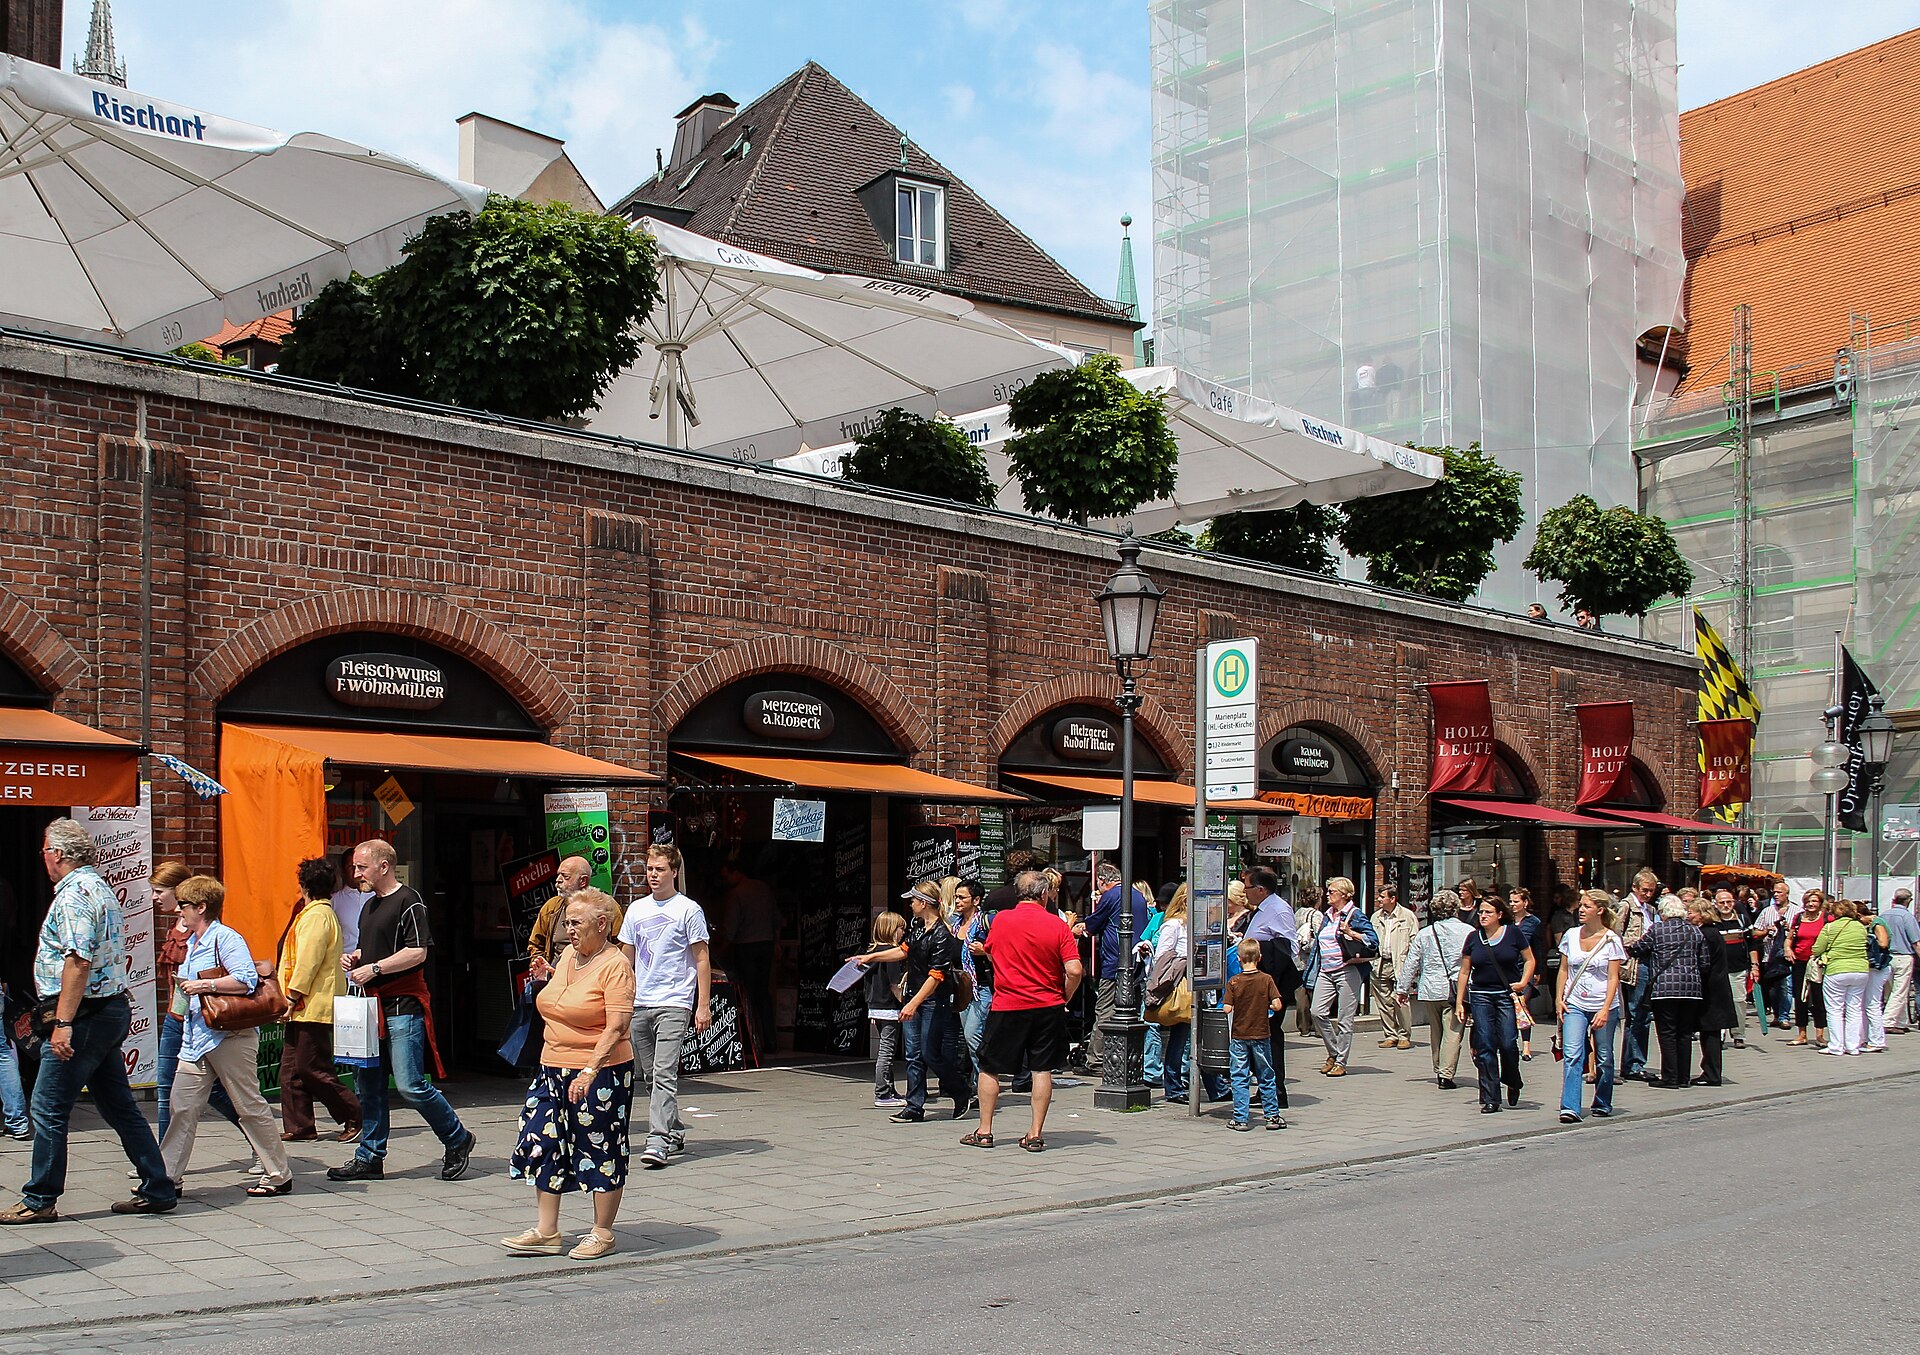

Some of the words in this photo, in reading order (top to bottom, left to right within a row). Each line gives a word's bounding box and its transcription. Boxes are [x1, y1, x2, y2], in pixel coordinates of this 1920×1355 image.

[92, 90, 207, 141] Rischart
[1210, 391, 1233, 414] Café
[1302, 418, 1343, 446] Rischart
[822, 458, 843, 475] Caf
[1395, 451, 1416, 471] Café
[1214, 712, 1248, 722] Marienplatz
[1070, 723, 1109, 740] Metzgerei
[1207, 721, 1255, 732] (Hl.-Geist-Kirche)
[1444, 725, 1490, 740] HOLZ
[1063, 735, 1089, 750] Rudolf
[1090, 737, 1116, 752] Maier
[1438, 741, 1493, 758] LEUTE
[1591, 745, 1629, 758] HOLZ
[1586, 760, 1626, 775] LEUT
[1708, 764, 1748, 781] LEUE
[90, 810, 106, 820] der
[106, 807, 138, 820] Woche!
[95, 829, 138, 848] Münchner
[1257, 824, 1292, 843] Leberkäs
[912, 838, 934, 851] Prima
[1264, 846, 1291, 854] Semmel
[95, 840, 142, 870] ißwürste
[109, 860, 123, 870] und
[515, 863, 551, 890] rivella
[126, 895, 145, 909] Cent
[130, 966, 151, 981] Cent
[137, 1059, 155, 1073] Cent
